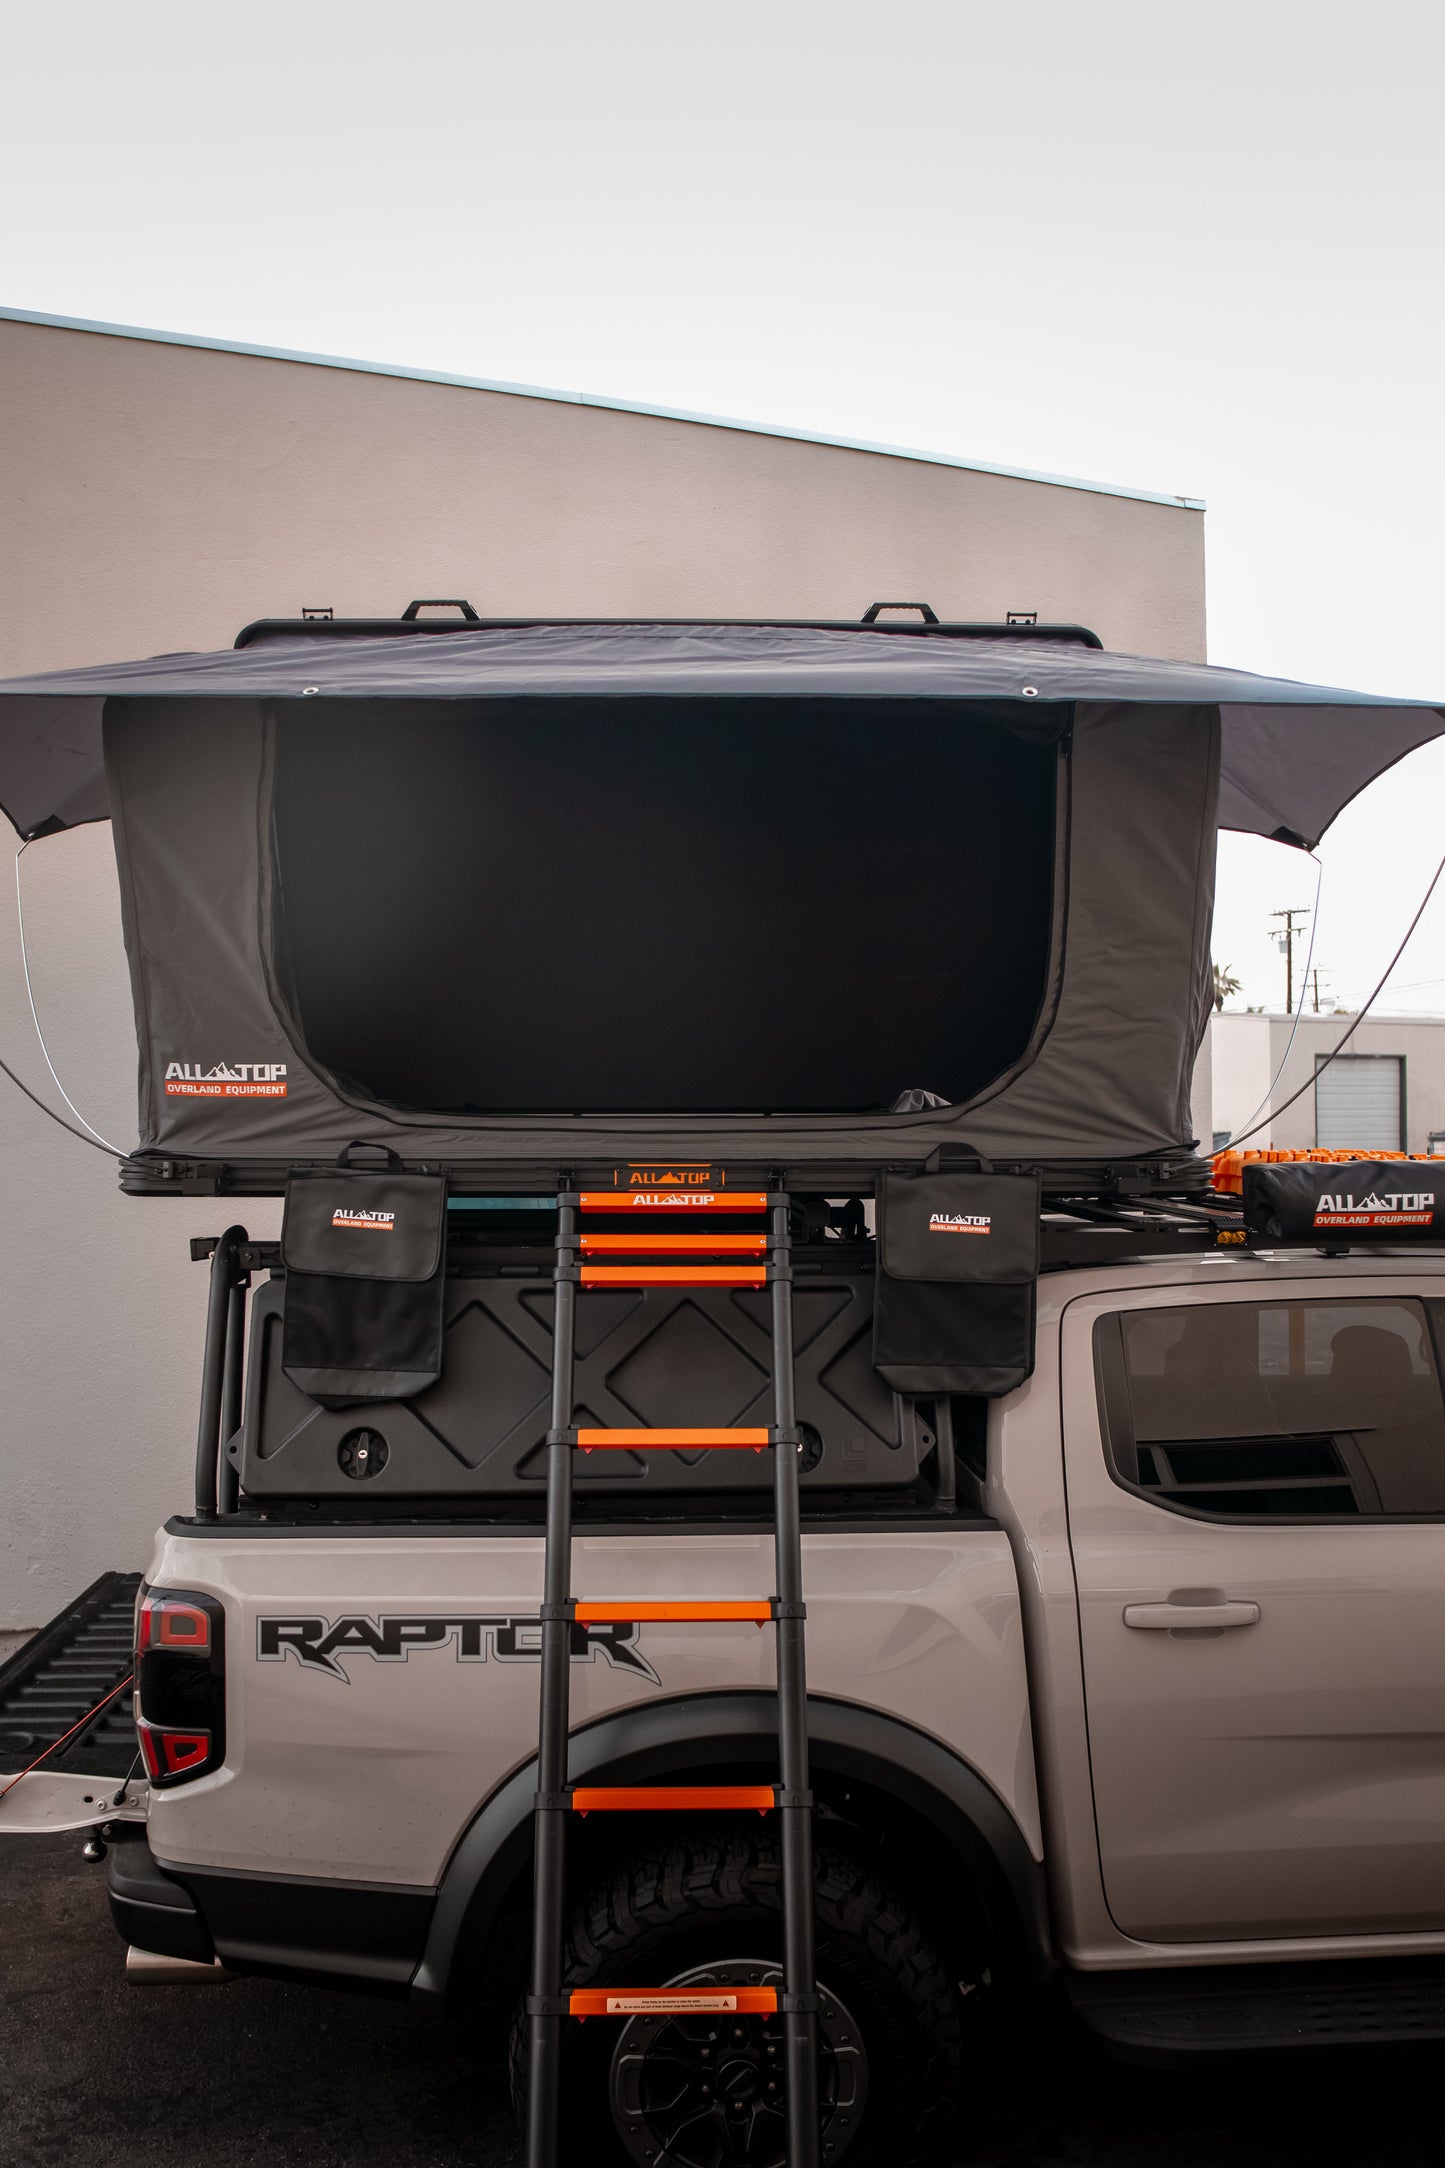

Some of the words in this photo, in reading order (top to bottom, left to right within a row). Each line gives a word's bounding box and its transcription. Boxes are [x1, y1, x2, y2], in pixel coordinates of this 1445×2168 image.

[167, 1084, 222, 1094] OVERLAND
[225, 1085, 285, 1095] EQUIPMENT
[1316, 1216, 1370, 1225] OVERLAND
[1374, 1214, 1431, 1224] EQUIPMENT
[256, 1614, 663, 1687] RAPTOR
